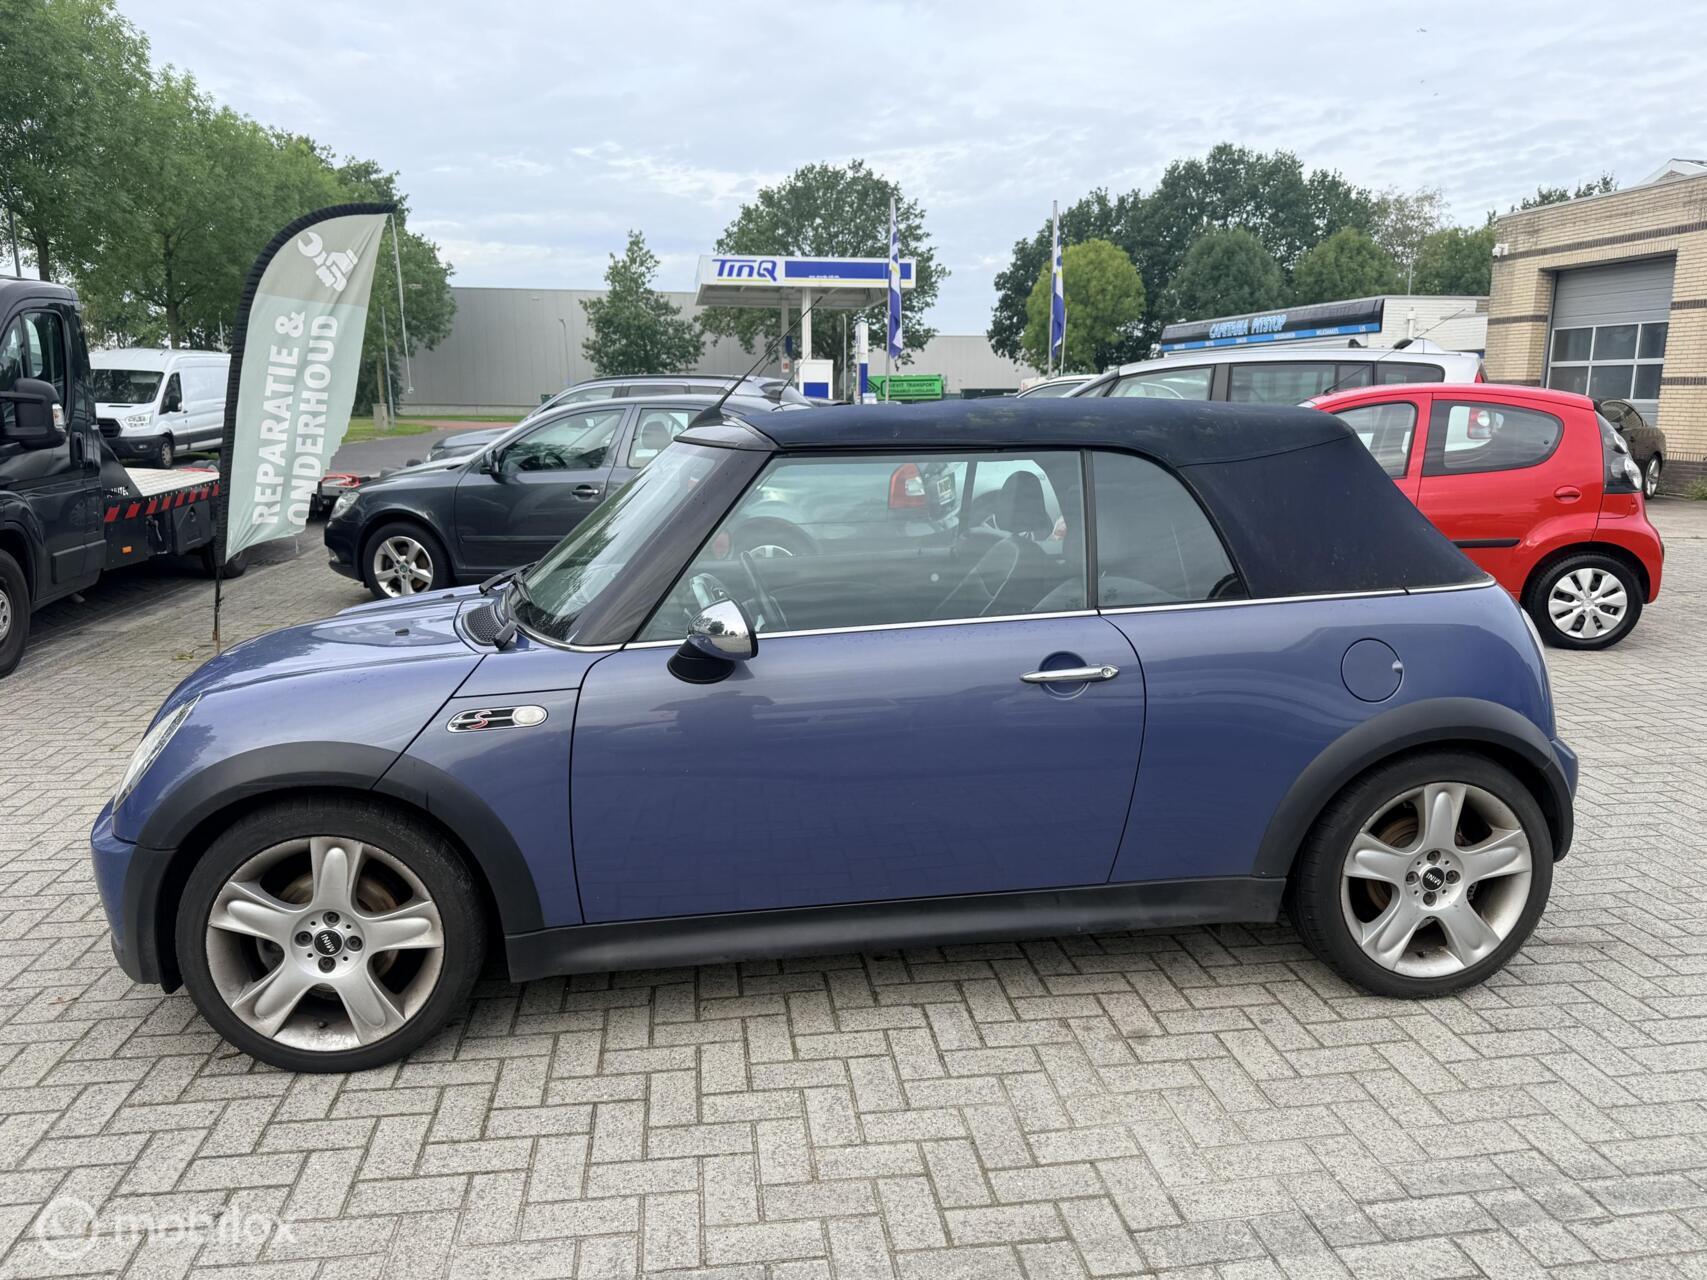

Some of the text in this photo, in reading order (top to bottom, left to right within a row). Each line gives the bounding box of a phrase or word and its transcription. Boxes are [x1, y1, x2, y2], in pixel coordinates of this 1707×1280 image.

[251, 311, 306, 525] REPARATIE &
[287, 315, 338, 527] ONDERHOUD
[1426, 873, 1441, 885] MINI
[321, 934, 336, 952] MINI
